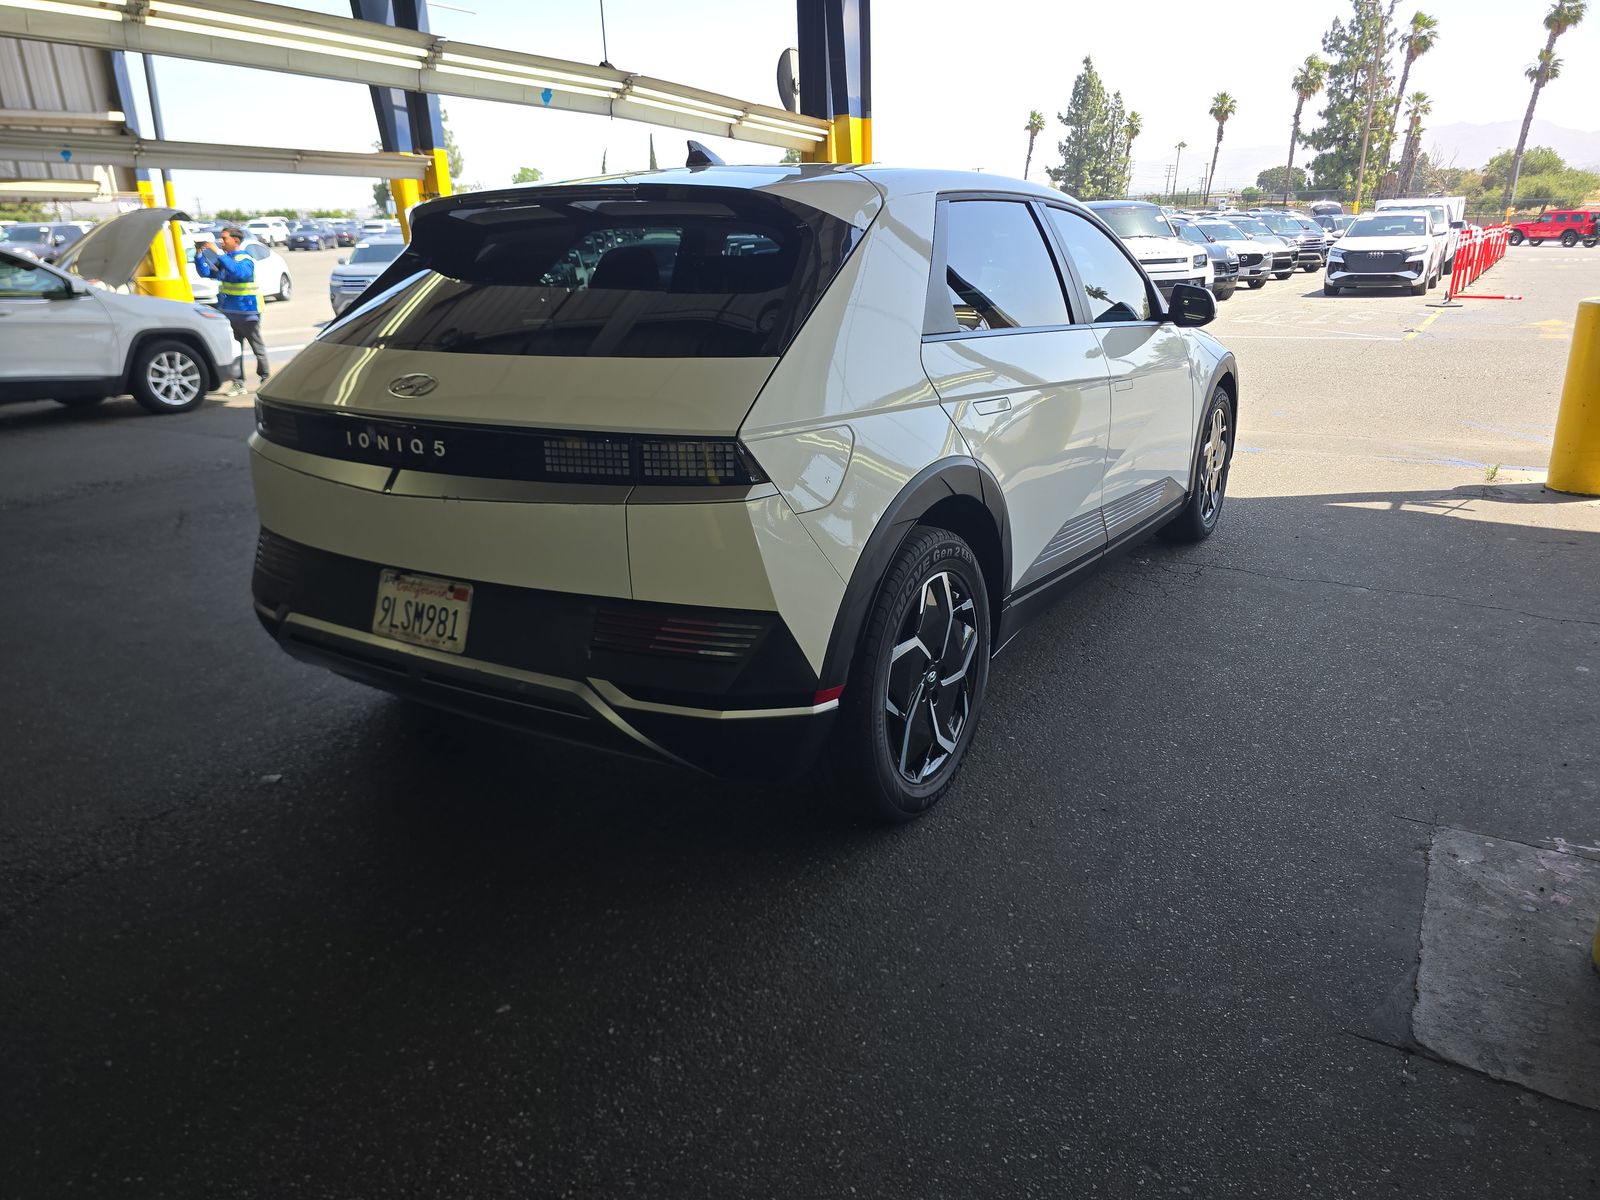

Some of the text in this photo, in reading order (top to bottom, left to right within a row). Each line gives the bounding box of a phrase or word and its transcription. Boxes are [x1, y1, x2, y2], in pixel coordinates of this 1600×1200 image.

[346, 431, 446, 457] IONIQ 5
[932, 548, 953, 562] Gen
[954, 546, 961, 557] 2
[378, 595, 459, 642] 9LSM981
